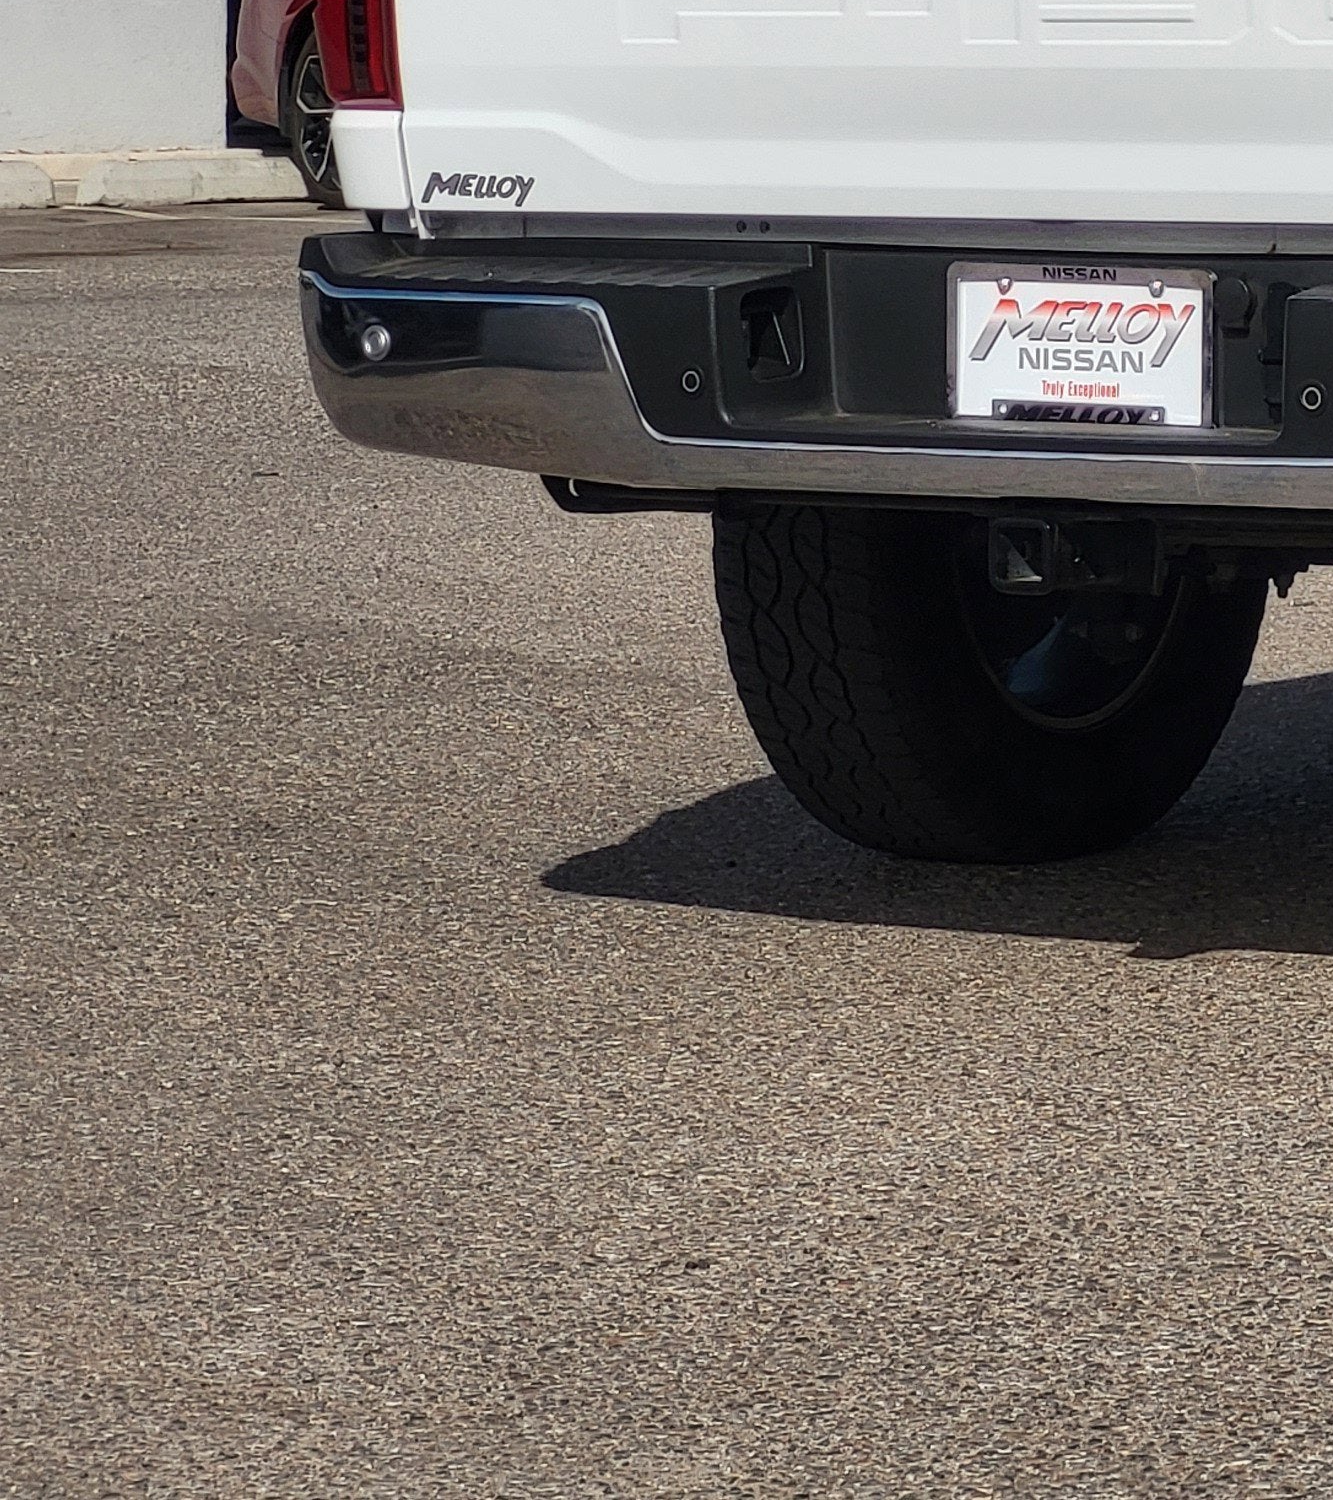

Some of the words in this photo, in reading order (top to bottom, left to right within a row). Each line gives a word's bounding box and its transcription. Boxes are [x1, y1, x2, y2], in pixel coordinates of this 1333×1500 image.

[421, 172, 535, 207] MELLOY
[1042, 266, 1117, 281] NISSAN
[969, 298, 1196, 369] MELLOY
[1018, 347, 1143, 373] NISSAN
[1041, 380, 1064, 399] Truly
[1068, 381, 1120, 399] Exceptional
[1004, 402, 1146, 424] MELLOY
